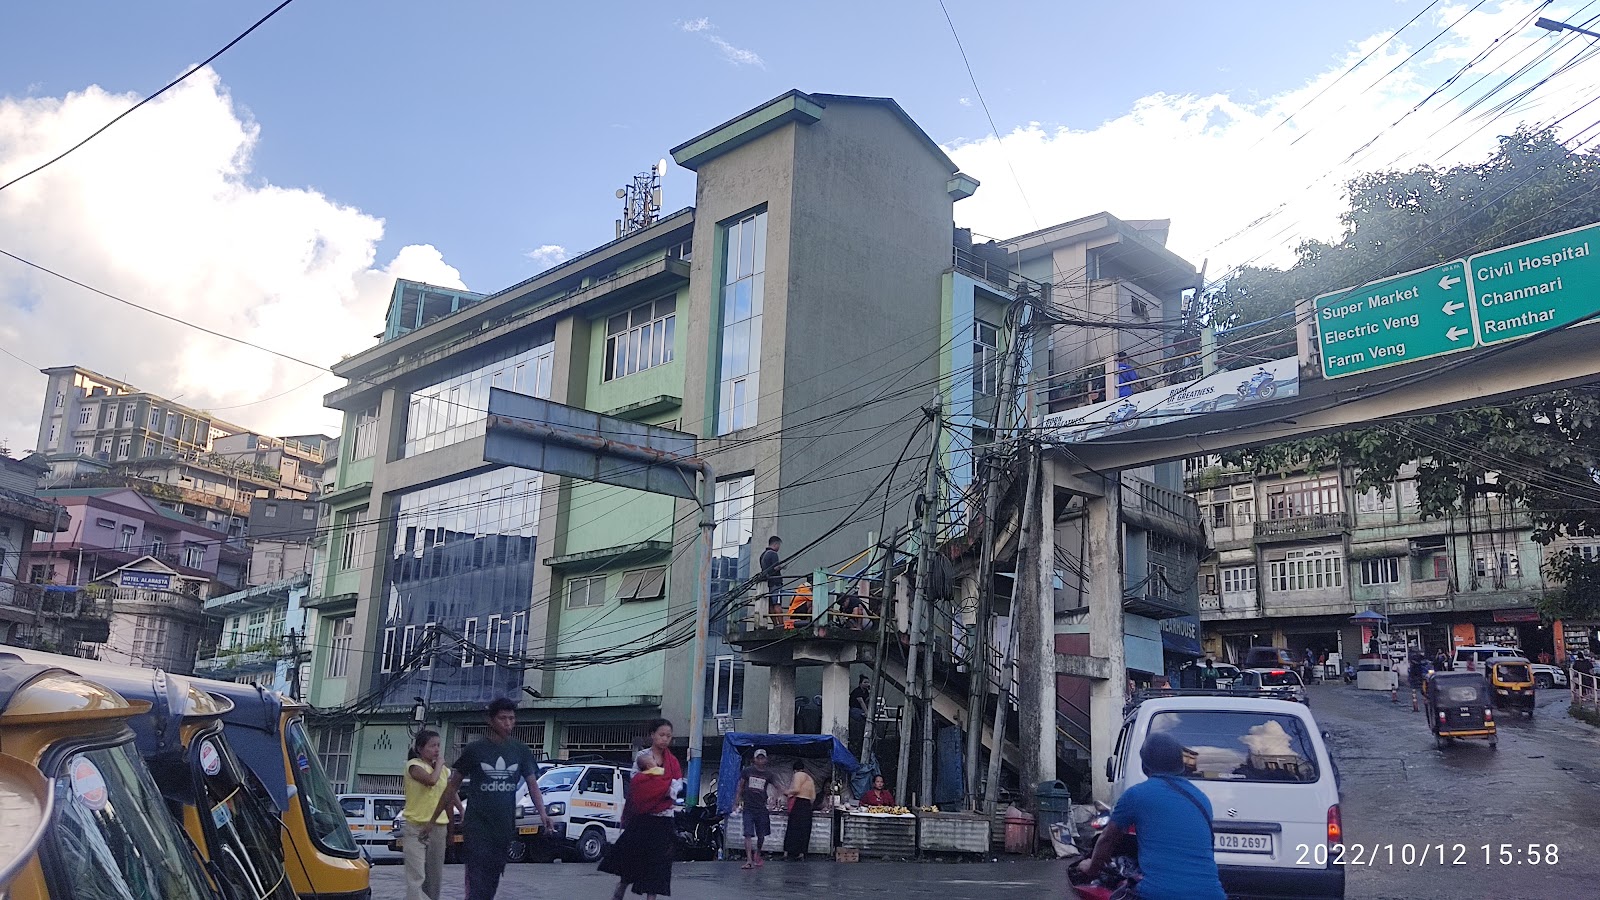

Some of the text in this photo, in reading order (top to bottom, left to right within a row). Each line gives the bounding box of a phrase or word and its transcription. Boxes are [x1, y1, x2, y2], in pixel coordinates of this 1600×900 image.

[1477, 243, 1590, 282] Civil Hospital
[1322, 286, 1419, 321] Super Market
[1481, 278, 1563, 307] Chanmari
[1325, 313, 1420, 344] Electric Veng
[1484, 309, 1556, 334] Ramthar
[1328, 342, 1406, 369] Farm Veng
[480, 781, 516, 791] adidas
[1220, 836, 1238, 848] 02B
[1242, 837, 1267, 848] 2697
